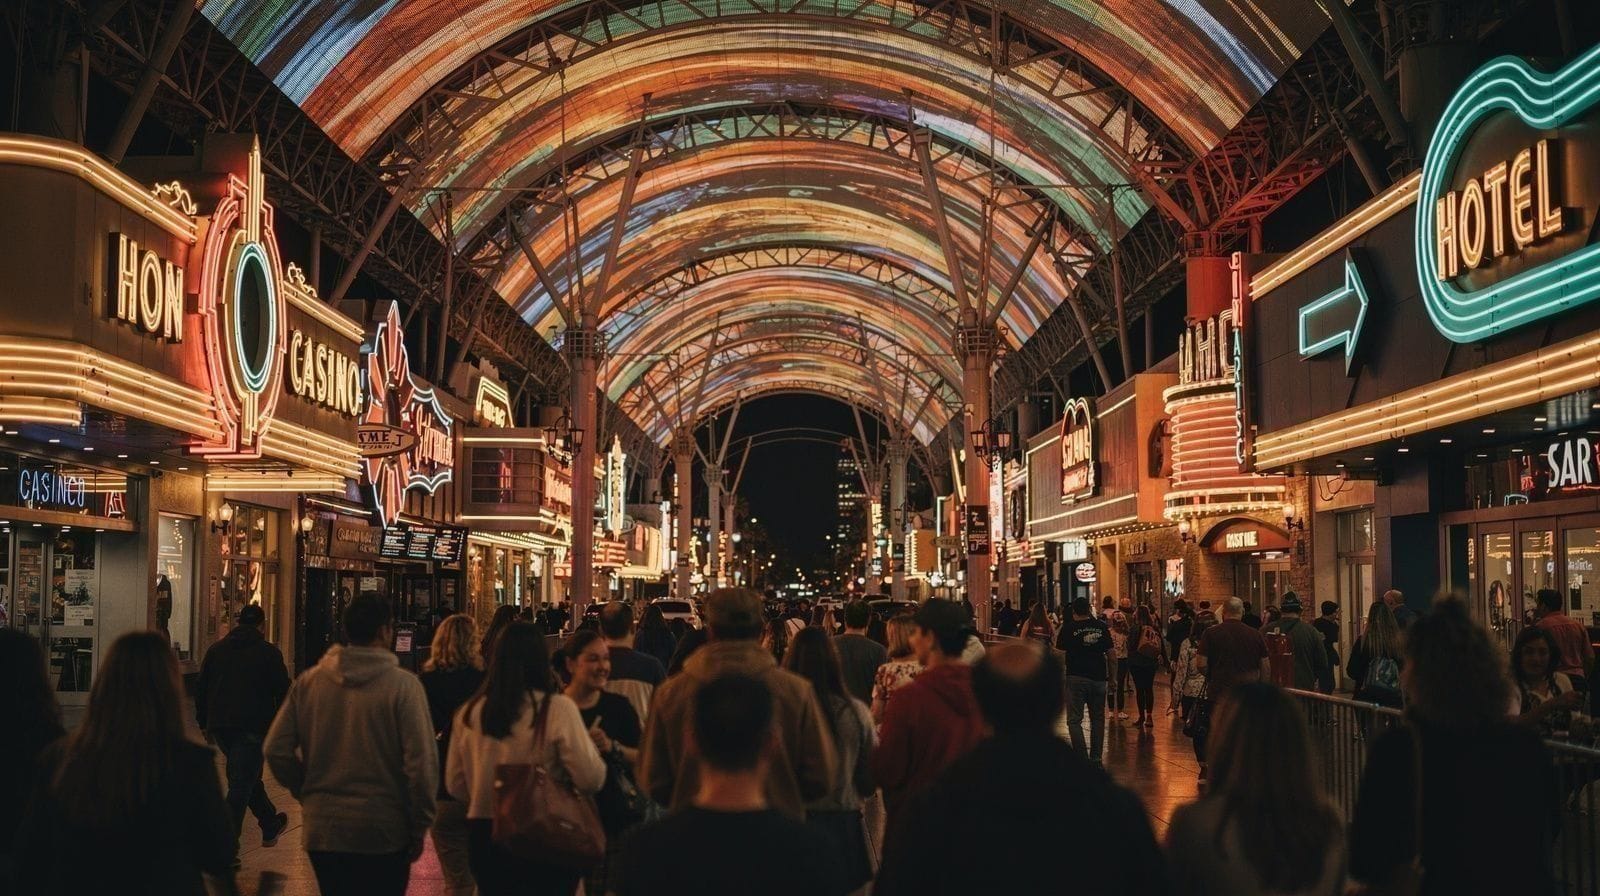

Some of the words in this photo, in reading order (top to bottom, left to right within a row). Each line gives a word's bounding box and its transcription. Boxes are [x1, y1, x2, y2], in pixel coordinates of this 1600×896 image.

[1436, 139, 1562, 281] HOTEL
[118, 232, 183, 343] HON
[290, 329, 361, 417] CASINO
[1547, 437, 1593, 489] SAR
